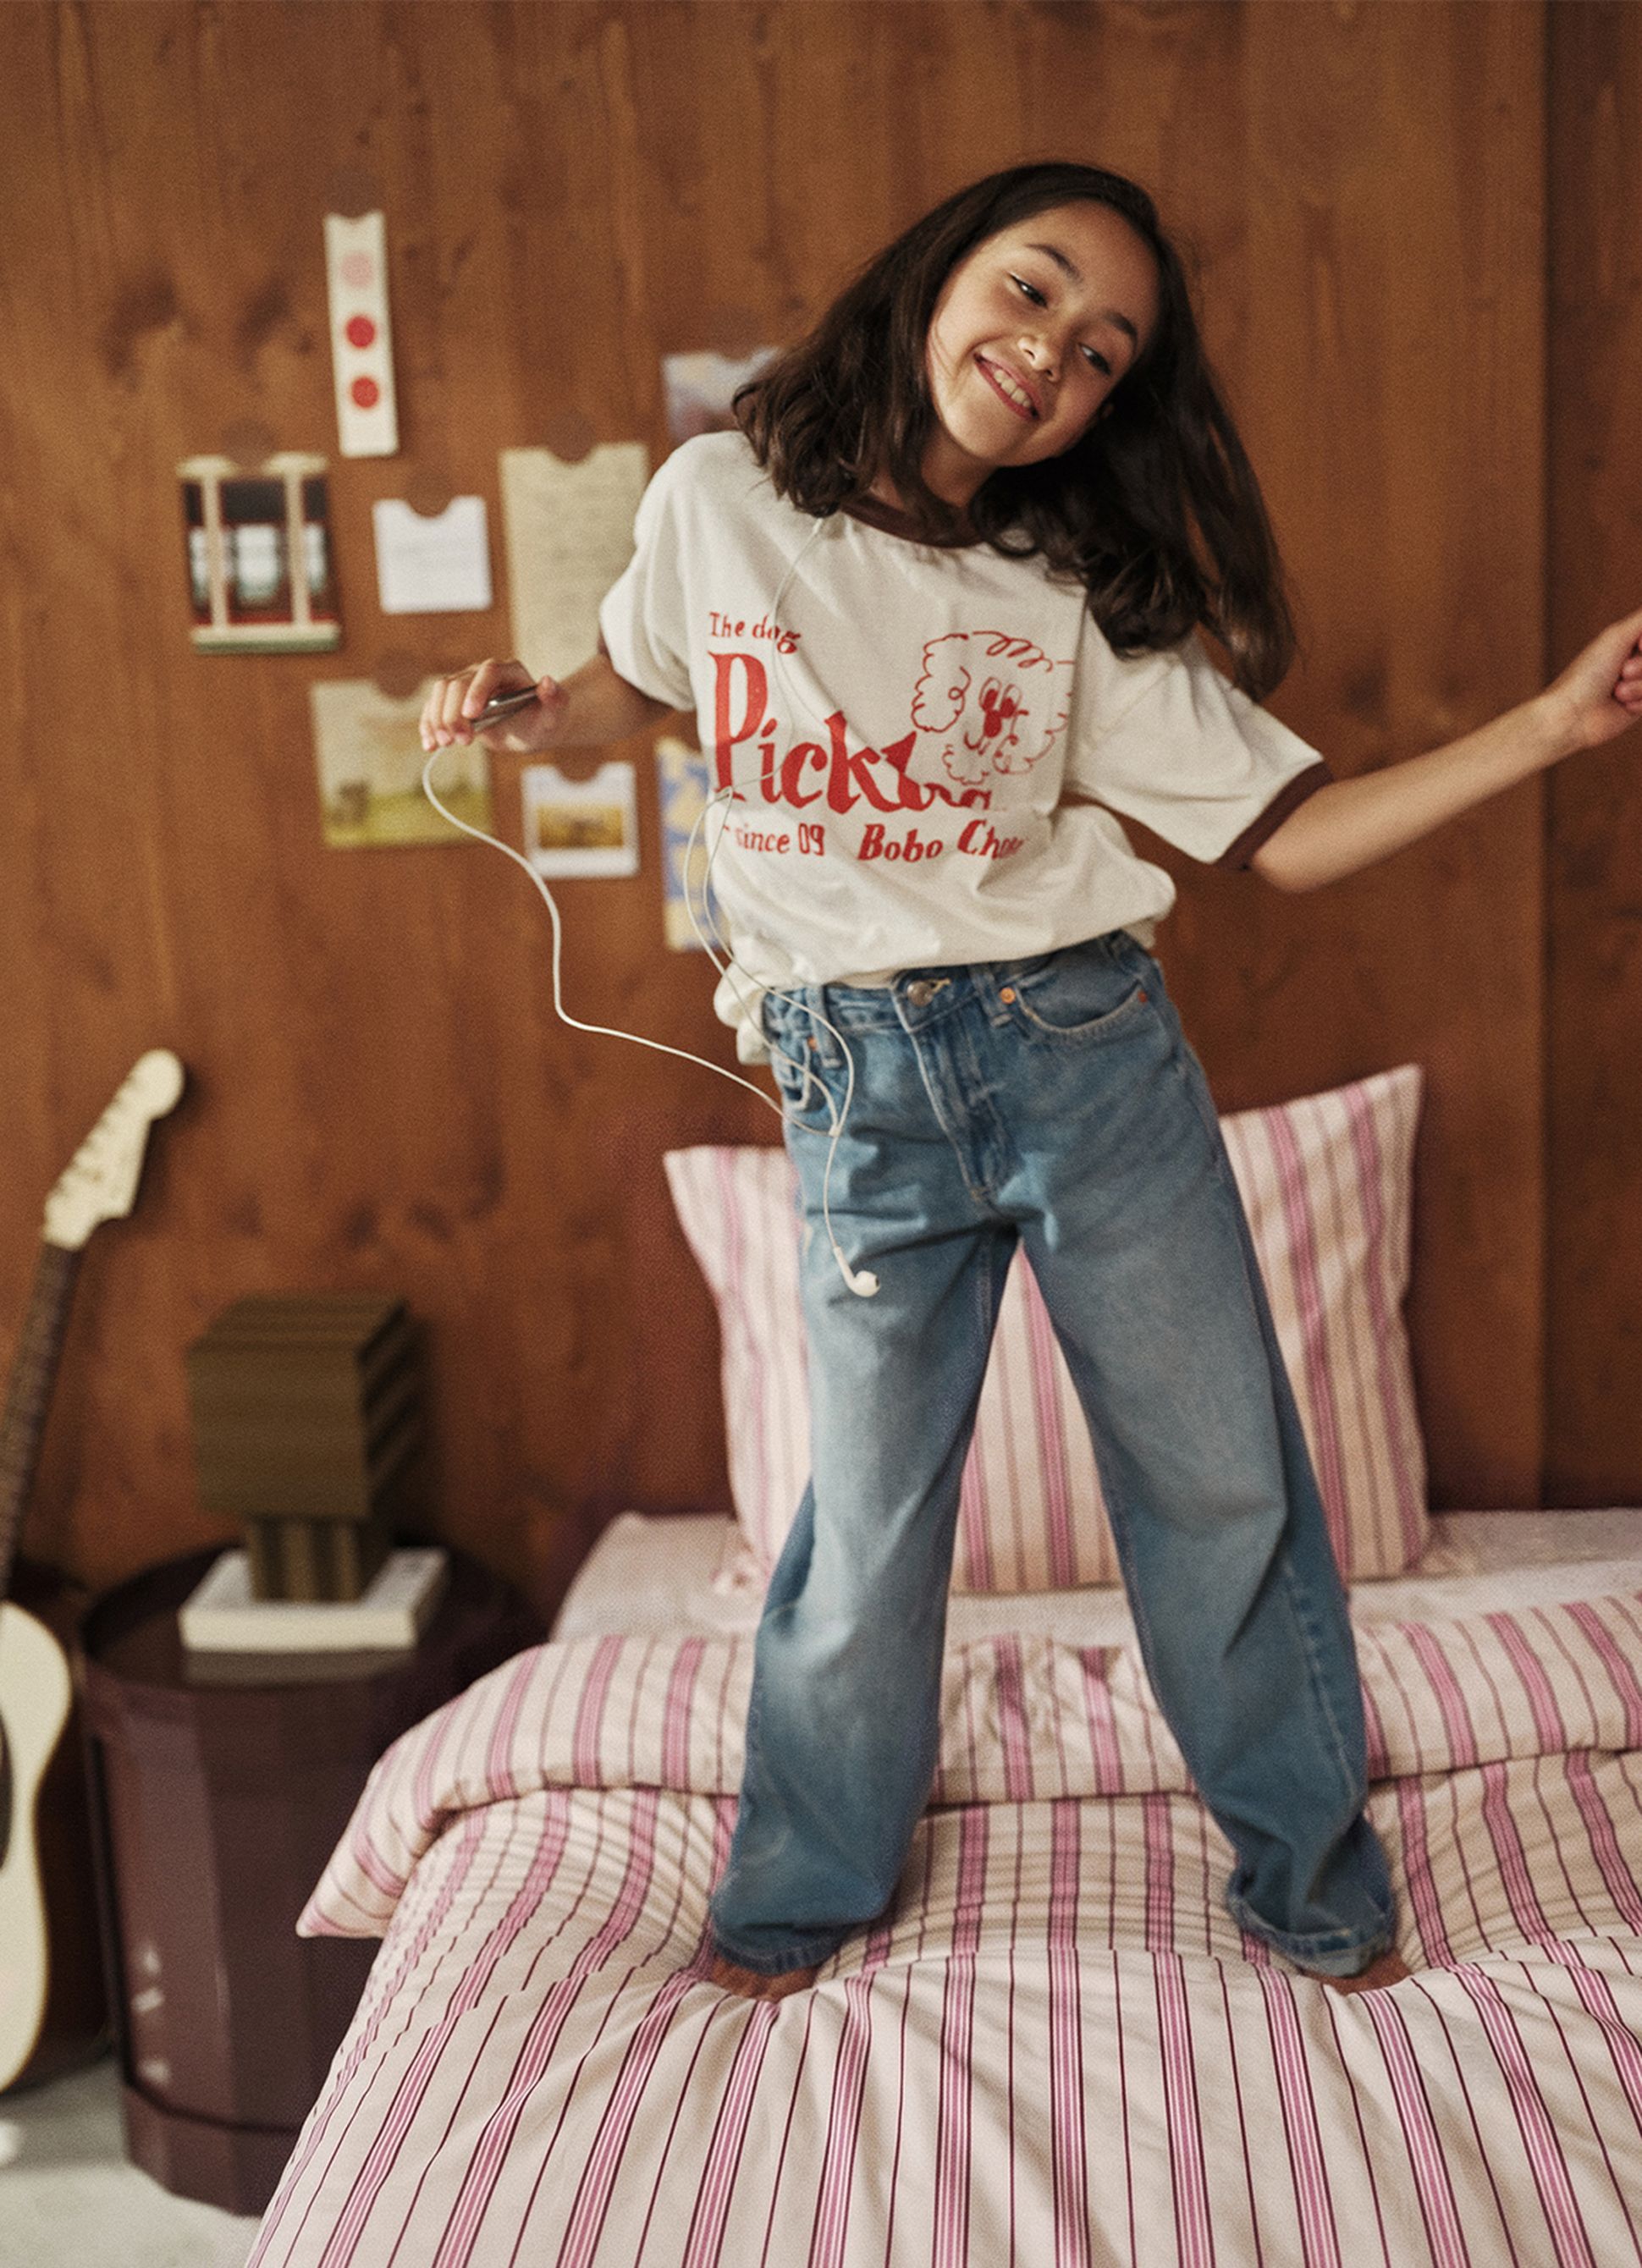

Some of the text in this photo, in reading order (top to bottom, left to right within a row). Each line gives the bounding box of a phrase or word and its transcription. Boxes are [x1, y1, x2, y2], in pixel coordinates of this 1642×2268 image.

[709, 611, 801, 654] The dog
[798, 823, 824, 856] 09
[857, 823, 943, 862] Bobo
